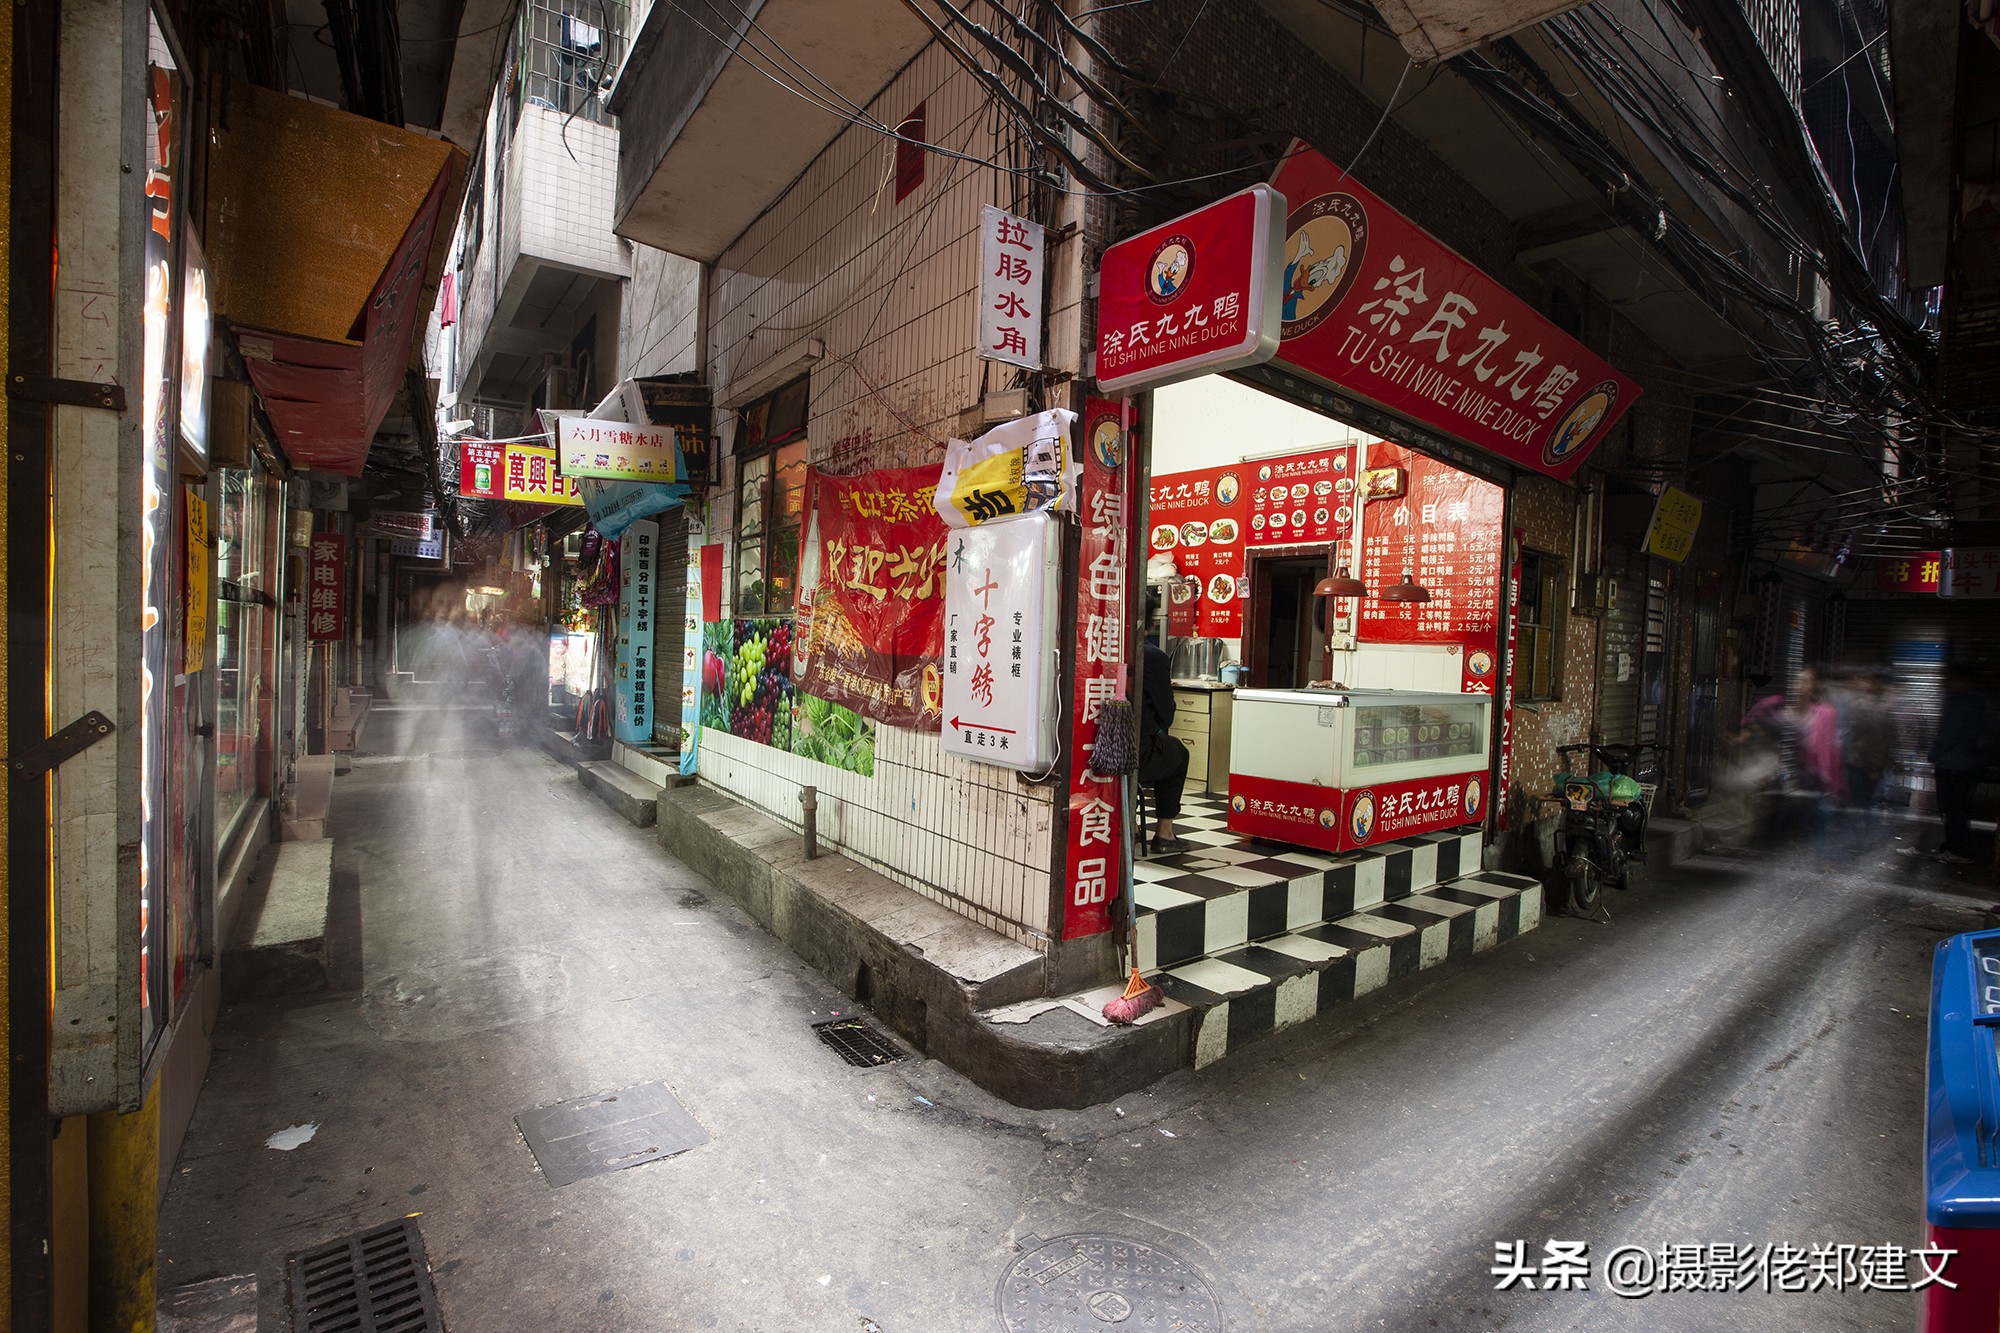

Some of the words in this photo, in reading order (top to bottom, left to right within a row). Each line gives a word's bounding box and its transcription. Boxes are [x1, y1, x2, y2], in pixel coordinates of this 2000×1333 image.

[1312, 199, 1364, 242] 涂氏九九鸭
[993, 216, 1033, 356] 拉肠水角
[1103, 291, 1240, 356] 涂氏九九鸭
[1294, 313, 1320, 334] DUCK
[1103, 356, 1116, 369] TU
[1118, 352, 1136, 366] SHI
[1139, 341, 1166, 358] NINE
[1169, 331, 1197, 350] NINE
[1201, 320, 1239, 341] DUCK
[1358, 254, 1580, 420] 涂氏九九鸭
[1337, 325, 1377, 364] TU
[1369, 345, 1415, 384] SHI
[1406, 363, 1462, 407] NINE
[1451, 387, 1502, 426] NINE
[1491, 407, 1542, 445] DUCK
[572, 427, 663, 448] 六月雪糖水店
[1275, 458, 1329, 473] 涂氏九九鸭
[1168, 500, 1185, 509] NINE
[1187, 497, 1209, 507] DUCK
[1393, 500, 1469, 527] 价目表
[1366, 536, 1389, 546] 热干面
[1403, 535, 1416, 544] 5元
[1366, 547, 1389, 556] 炸酱面
[1402, 545, 1416, 555] 5元
[1365, 557, 1381, 566] 水饺
[1401, 556, 1414, 566] 5元
[1420, 566, 1454, 576] 爽口鸭翅
[1469, 565, 1496, 575] 2元/个
[1945, 552, 1999, 570] 汕头牛
[311, 540, 338, 634] 家电维修
[636, 535, 650, 632] 印花百分百十字绣
[1467, 588, 1494, 598] 4元/个
[1951, 572, 2000, 594] 牛
[1363, 600, 1379, 609] 汤面
[1363, 610, 1386, 620] 瘦肉面
[1399, 611, 1412, 620] 5元
[1418, 611, 1451, 620] 上等鸭架
[1467, 611, 1493, 621] 2元/个
[1457, 623, 1492, 633] 2.5元/个
[949, 614, 958, 675] 厂家直销
[1011, 611, 1023, 678] 专业裱框
[633, 646, 647, 726] 厂家裱框超低价
[964, 730, 1009, 750] 直走3米
[1250, 799, 1315, 819] 涂氏九九鸭
[1381, 784, 1460, 818] 涂氏九九鸭
[1269, 812, 1282, 820] NINE
[1283, 814, 1297, 823] NINE
[1298, 817, 1315, 825] DUCK
[1381, 820, 1391, 832] TU
[1392, 818, 1404, 830] SHI
[1405, 814, 1422, 827] NINE
[1423, 810, 1439, 823] NINE
[1440, 807, 1459, 820] DUCK
